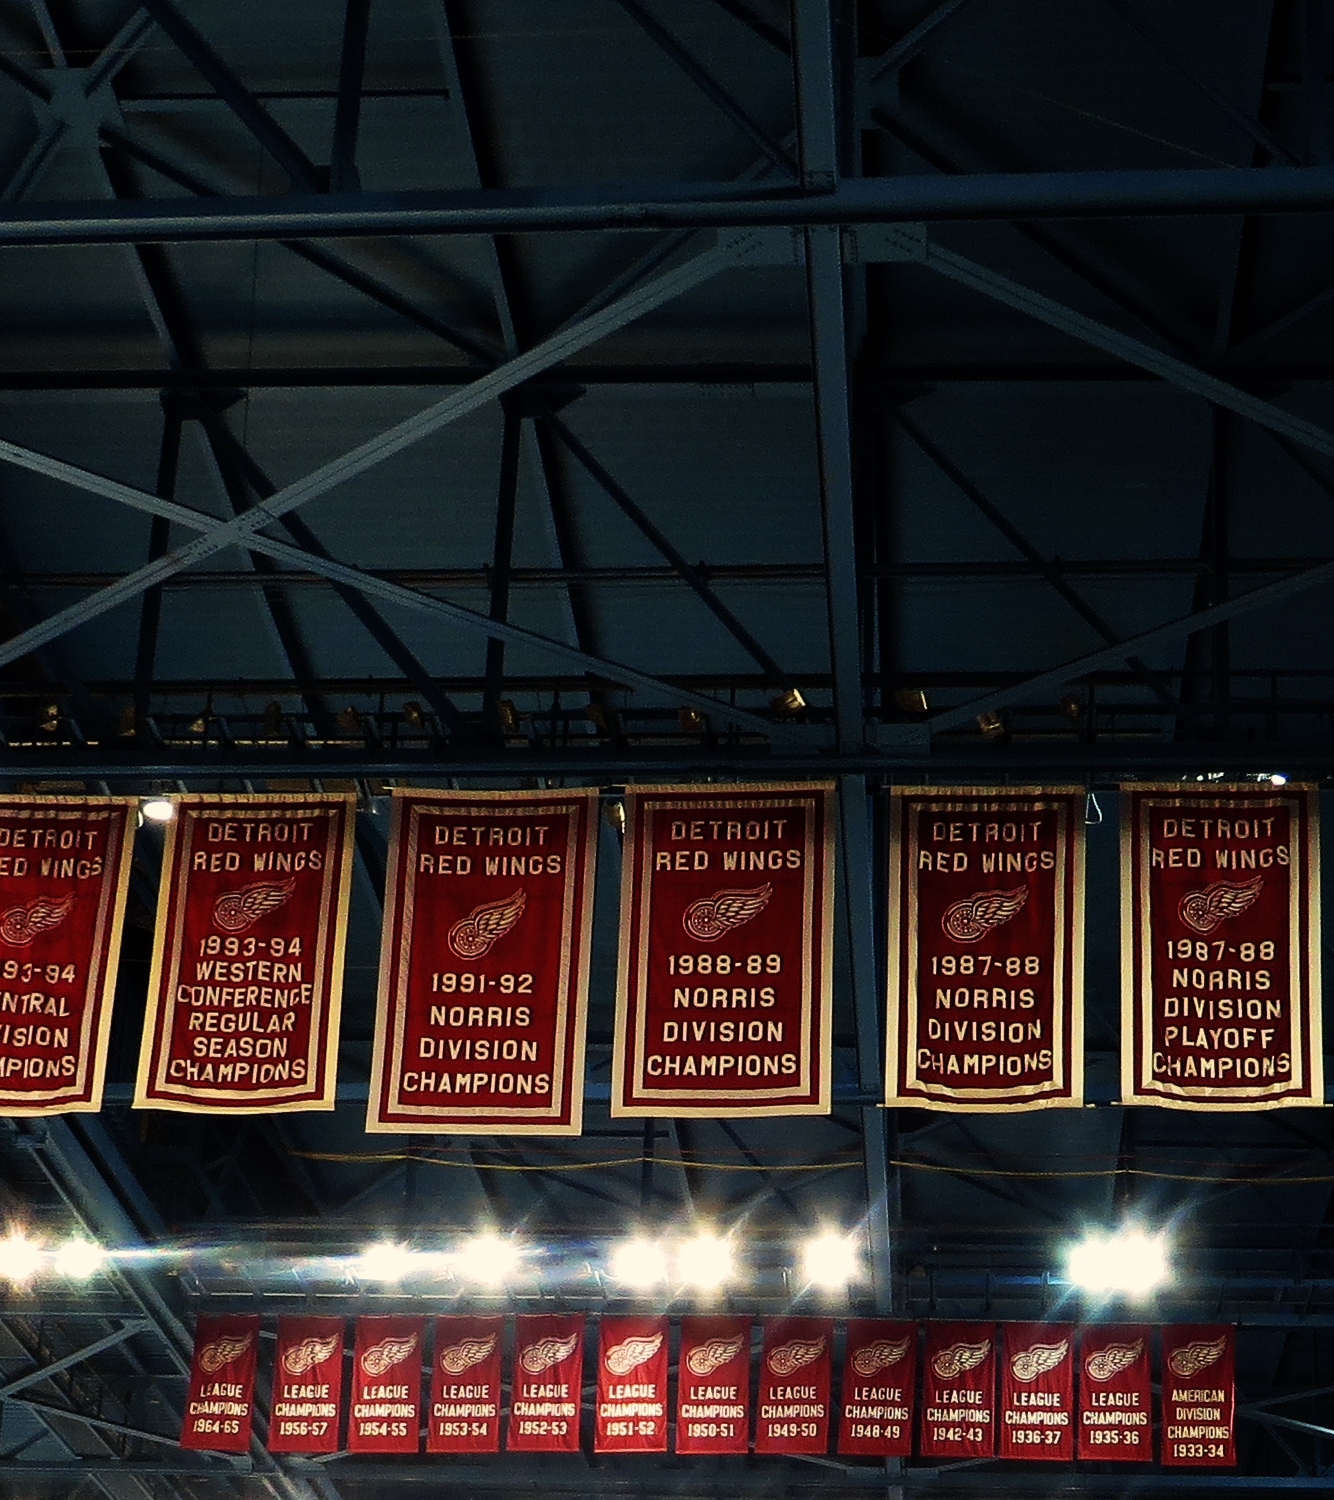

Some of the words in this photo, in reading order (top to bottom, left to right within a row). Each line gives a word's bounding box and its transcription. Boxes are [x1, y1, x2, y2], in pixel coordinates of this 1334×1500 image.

[209, 822, 313, 843] DETROIT
[435, 826, 549, 846] DETROIT
[672, 820, 786, 840] DETROIT
[934, 822, 1041, 842] DETROIT
[1164, 818, 1275, 839] DETROIT
[194, 852, 239, 872] RED
[254, 850, 322, 872] WINGS
[420, 854, 471, 874] RED
[485, 854, 561, 875] WINGS
[656, 850, 708, 871] RED
[724, 849, 801, 871] WINGS
[920, 851, 967, 873] RED
[983, 851, 1055, 873] WINGS
[1153, 848, 1200, 868] RED
[1215, 846, 1290, 868] WINGS
[42, 856, 102, 879] WINGS
[200, 937, 301, 957] 1993-94
[1167, 940, 1275, 961] 1987-88
[196, 961, 302, 983] WESTERN
[668, 955, 781, 975] 1988-89
[932, 956, 1039, 976] 1987-88
[432, 973, 533, 993] 1991-92
[1173, 969, 1270, 989] NORRIS
[177, 983, 312, 1008] CONFERENCE
[674, 988, 774, 1008] NORRIS
[936, 988, 1034, 1009] NORRIS
[430, 1006, 530, 1026] NORRIS
[1165, 998, 1281, 1020] DIVISION
[189, 1011, 295, 1033] REGULAR
[664, 1021, 783, 1042] DIVISION
[929, 1019, 1041, 1043] DIVISION
[193, 1037, 286, 1058] SEASON
[1165, 1027, 1275, 1049] PLAYOFF
[420, 1038, 537, 1061] DIVISION
[170, 1058, 305, 1083] CHAMPIONS
[647, 1054, 796, 1076] CHAMPIONS
[918, 1048, 1051, 1076] CHAMPIONS
[1154, 1053, 1290, 1078] CHAMPIONS
[404, 1070, 549, 1095] CHAMPIONS
[284, 1385, 329, 1398] LEAGUE
[523, 1384, 568, 1398] LEAGUE
[609, 1385, 655, 1398] LEAGUE
[690, 1387, 737, 1399] LEAGUE
[936, 1390, 982, 1404] LEAGUE
[1013, 1392, 1060, 1407] LEAGUE
[1091, 1392, 1139, 1406] LEAGUE
[1172, 1389, 1225, 1403] AMERICAN
[275, 1403, 336, 1417] CHAMPIONS
[514, 1403, 575, 1416] CHAMPIONS
[600, 1403, 663, 1417] CHAMPIONS
[681, 1405, 744, 1418] CHAMPIONS
[927, 1409, 990, 1423] CHAMPIONS
[1005, 1411, 1069, 1426] CHAMPIONS
[1083, 1411, 1147, 1426] CHAMPIONS
[1176, 1408, 1220, 1421] DIVISION
[280, 1422, 328, 1435] 1956-57
[519, 1421, 567, 1435] 1952-53
[607, 1422, 655, 1436] 1951-52
[688, 1424, 734, 1437] 1950-51
[933, 1428, 982, 1441] 1942-43
[1012, 1430, 1060, 1444] 1936-37
[1090, 1430, 1139, 1444] 1935-36
[1168, 1426, 1229, 1439] CHAMPIONS
[1173, 1444, 1224, 1457] 1933-34
